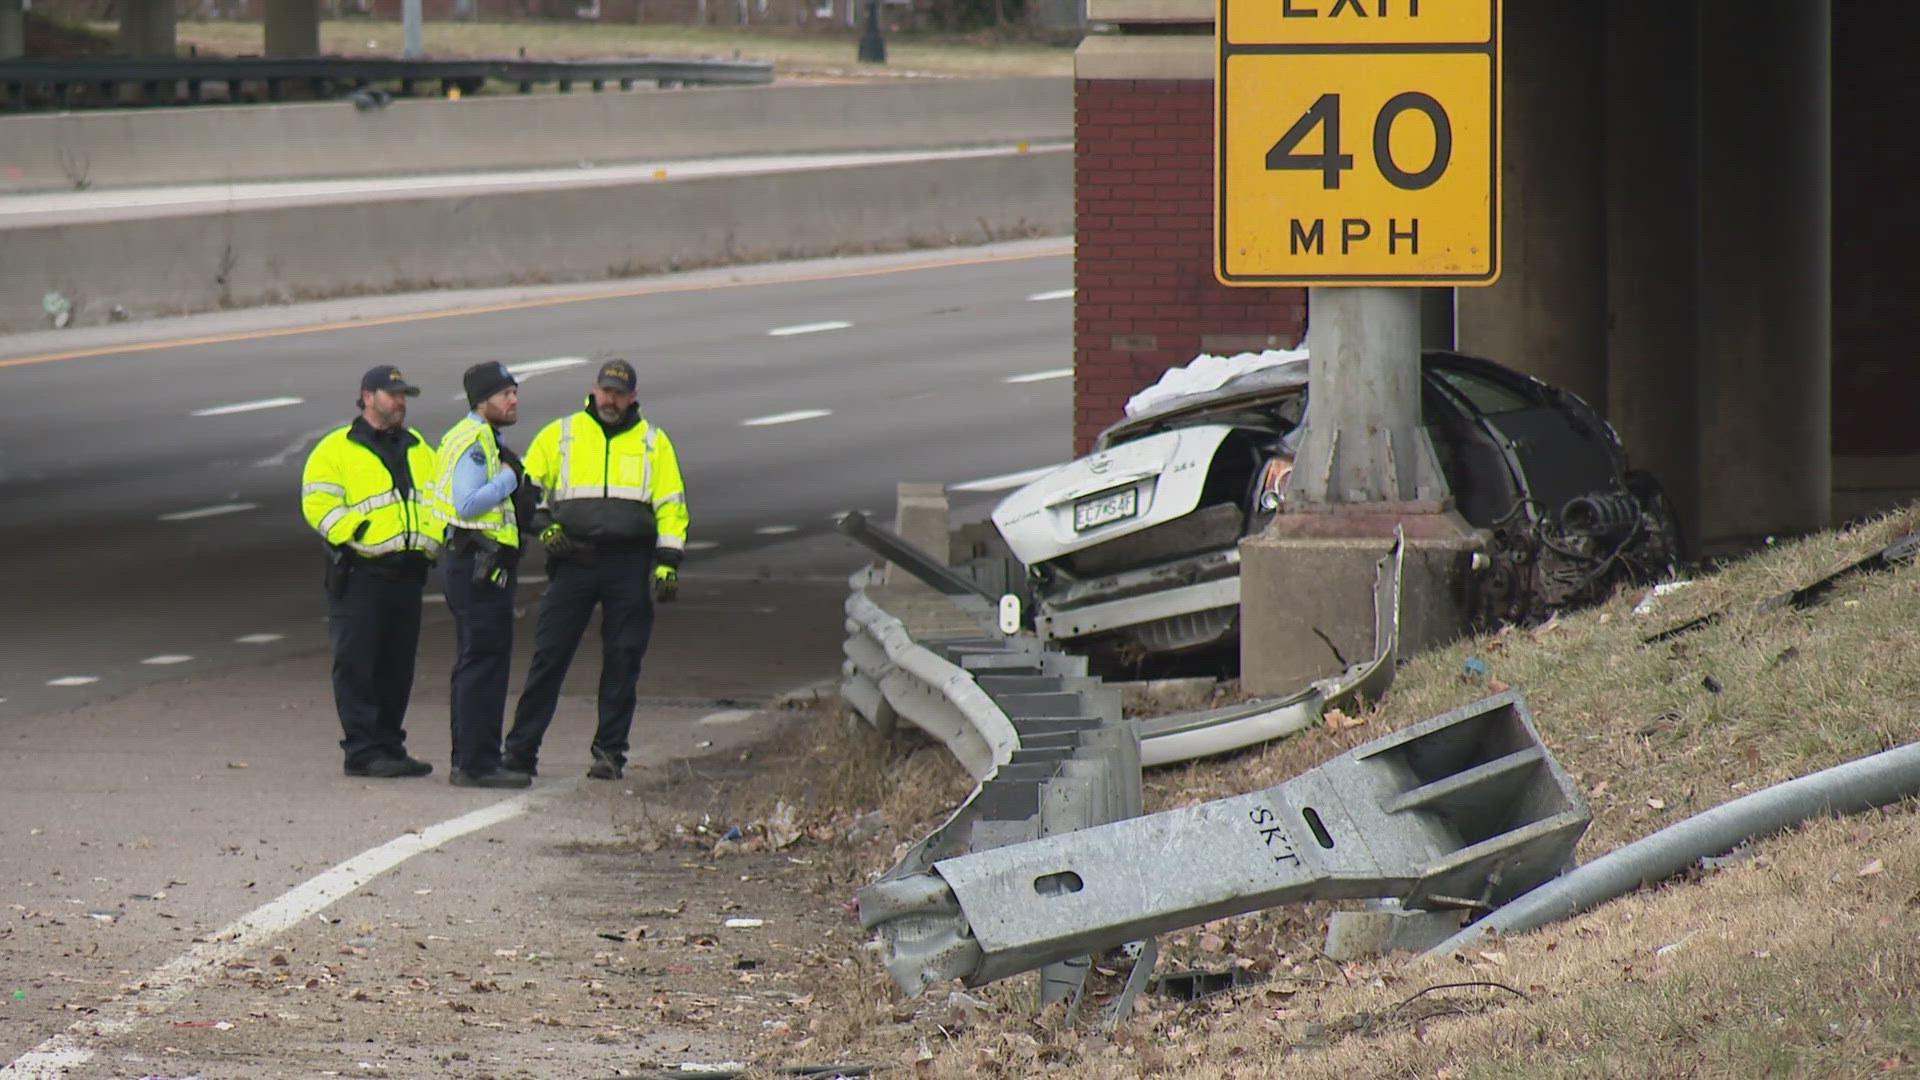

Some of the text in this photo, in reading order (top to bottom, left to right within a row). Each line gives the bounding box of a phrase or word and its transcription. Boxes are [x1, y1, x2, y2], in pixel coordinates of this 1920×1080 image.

[1265, 91, 1453, 190] 40
[1290, 219, 1418, 255] MPH
[1249, 809, 1300, 867] SKT
